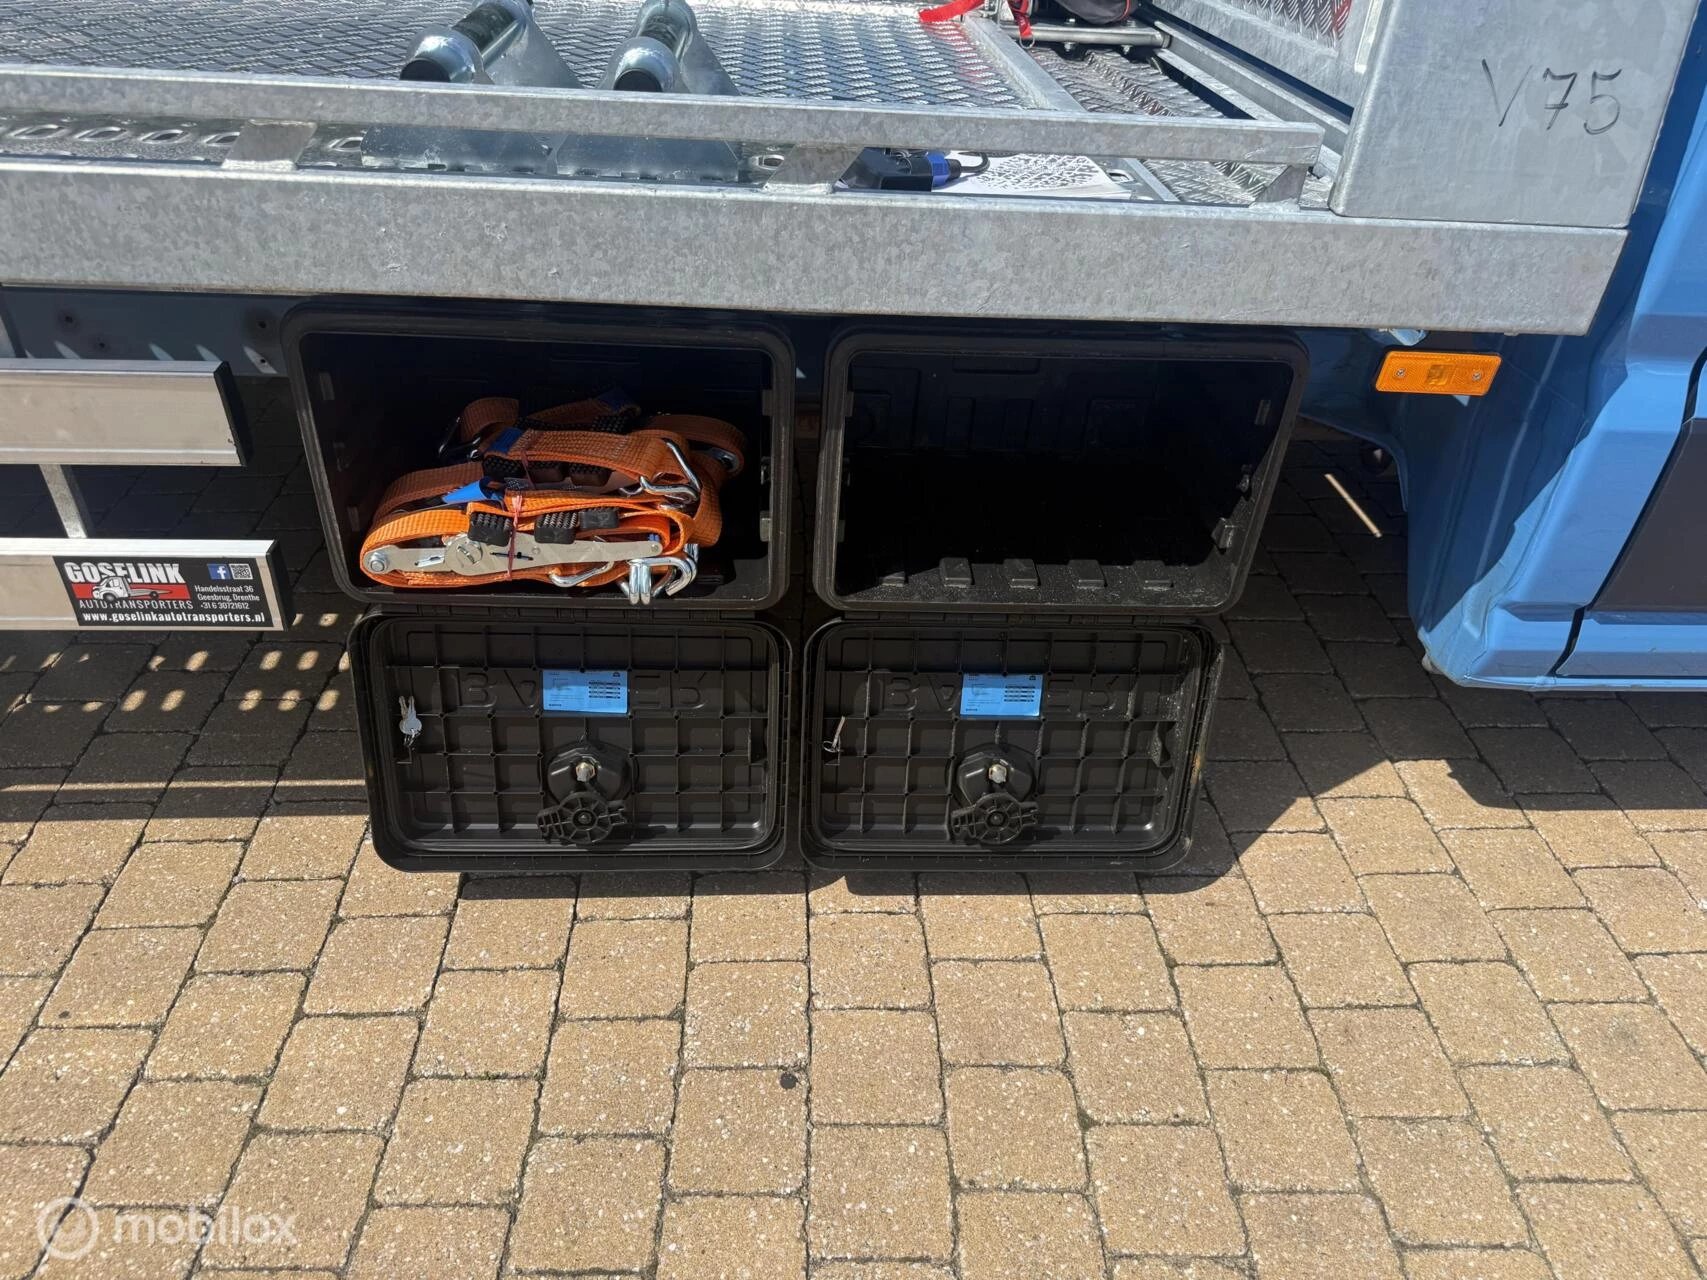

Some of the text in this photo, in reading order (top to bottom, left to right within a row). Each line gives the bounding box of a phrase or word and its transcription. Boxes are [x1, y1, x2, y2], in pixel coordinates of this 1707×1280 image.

[63, 561, 187, 584] GOSELINK
[194, 584, 243, 593] Handelsstraat
[232, 593, 260, 602] Drenthe
[82, 611, 266, 623] www.goselinkautotransporters.nl
